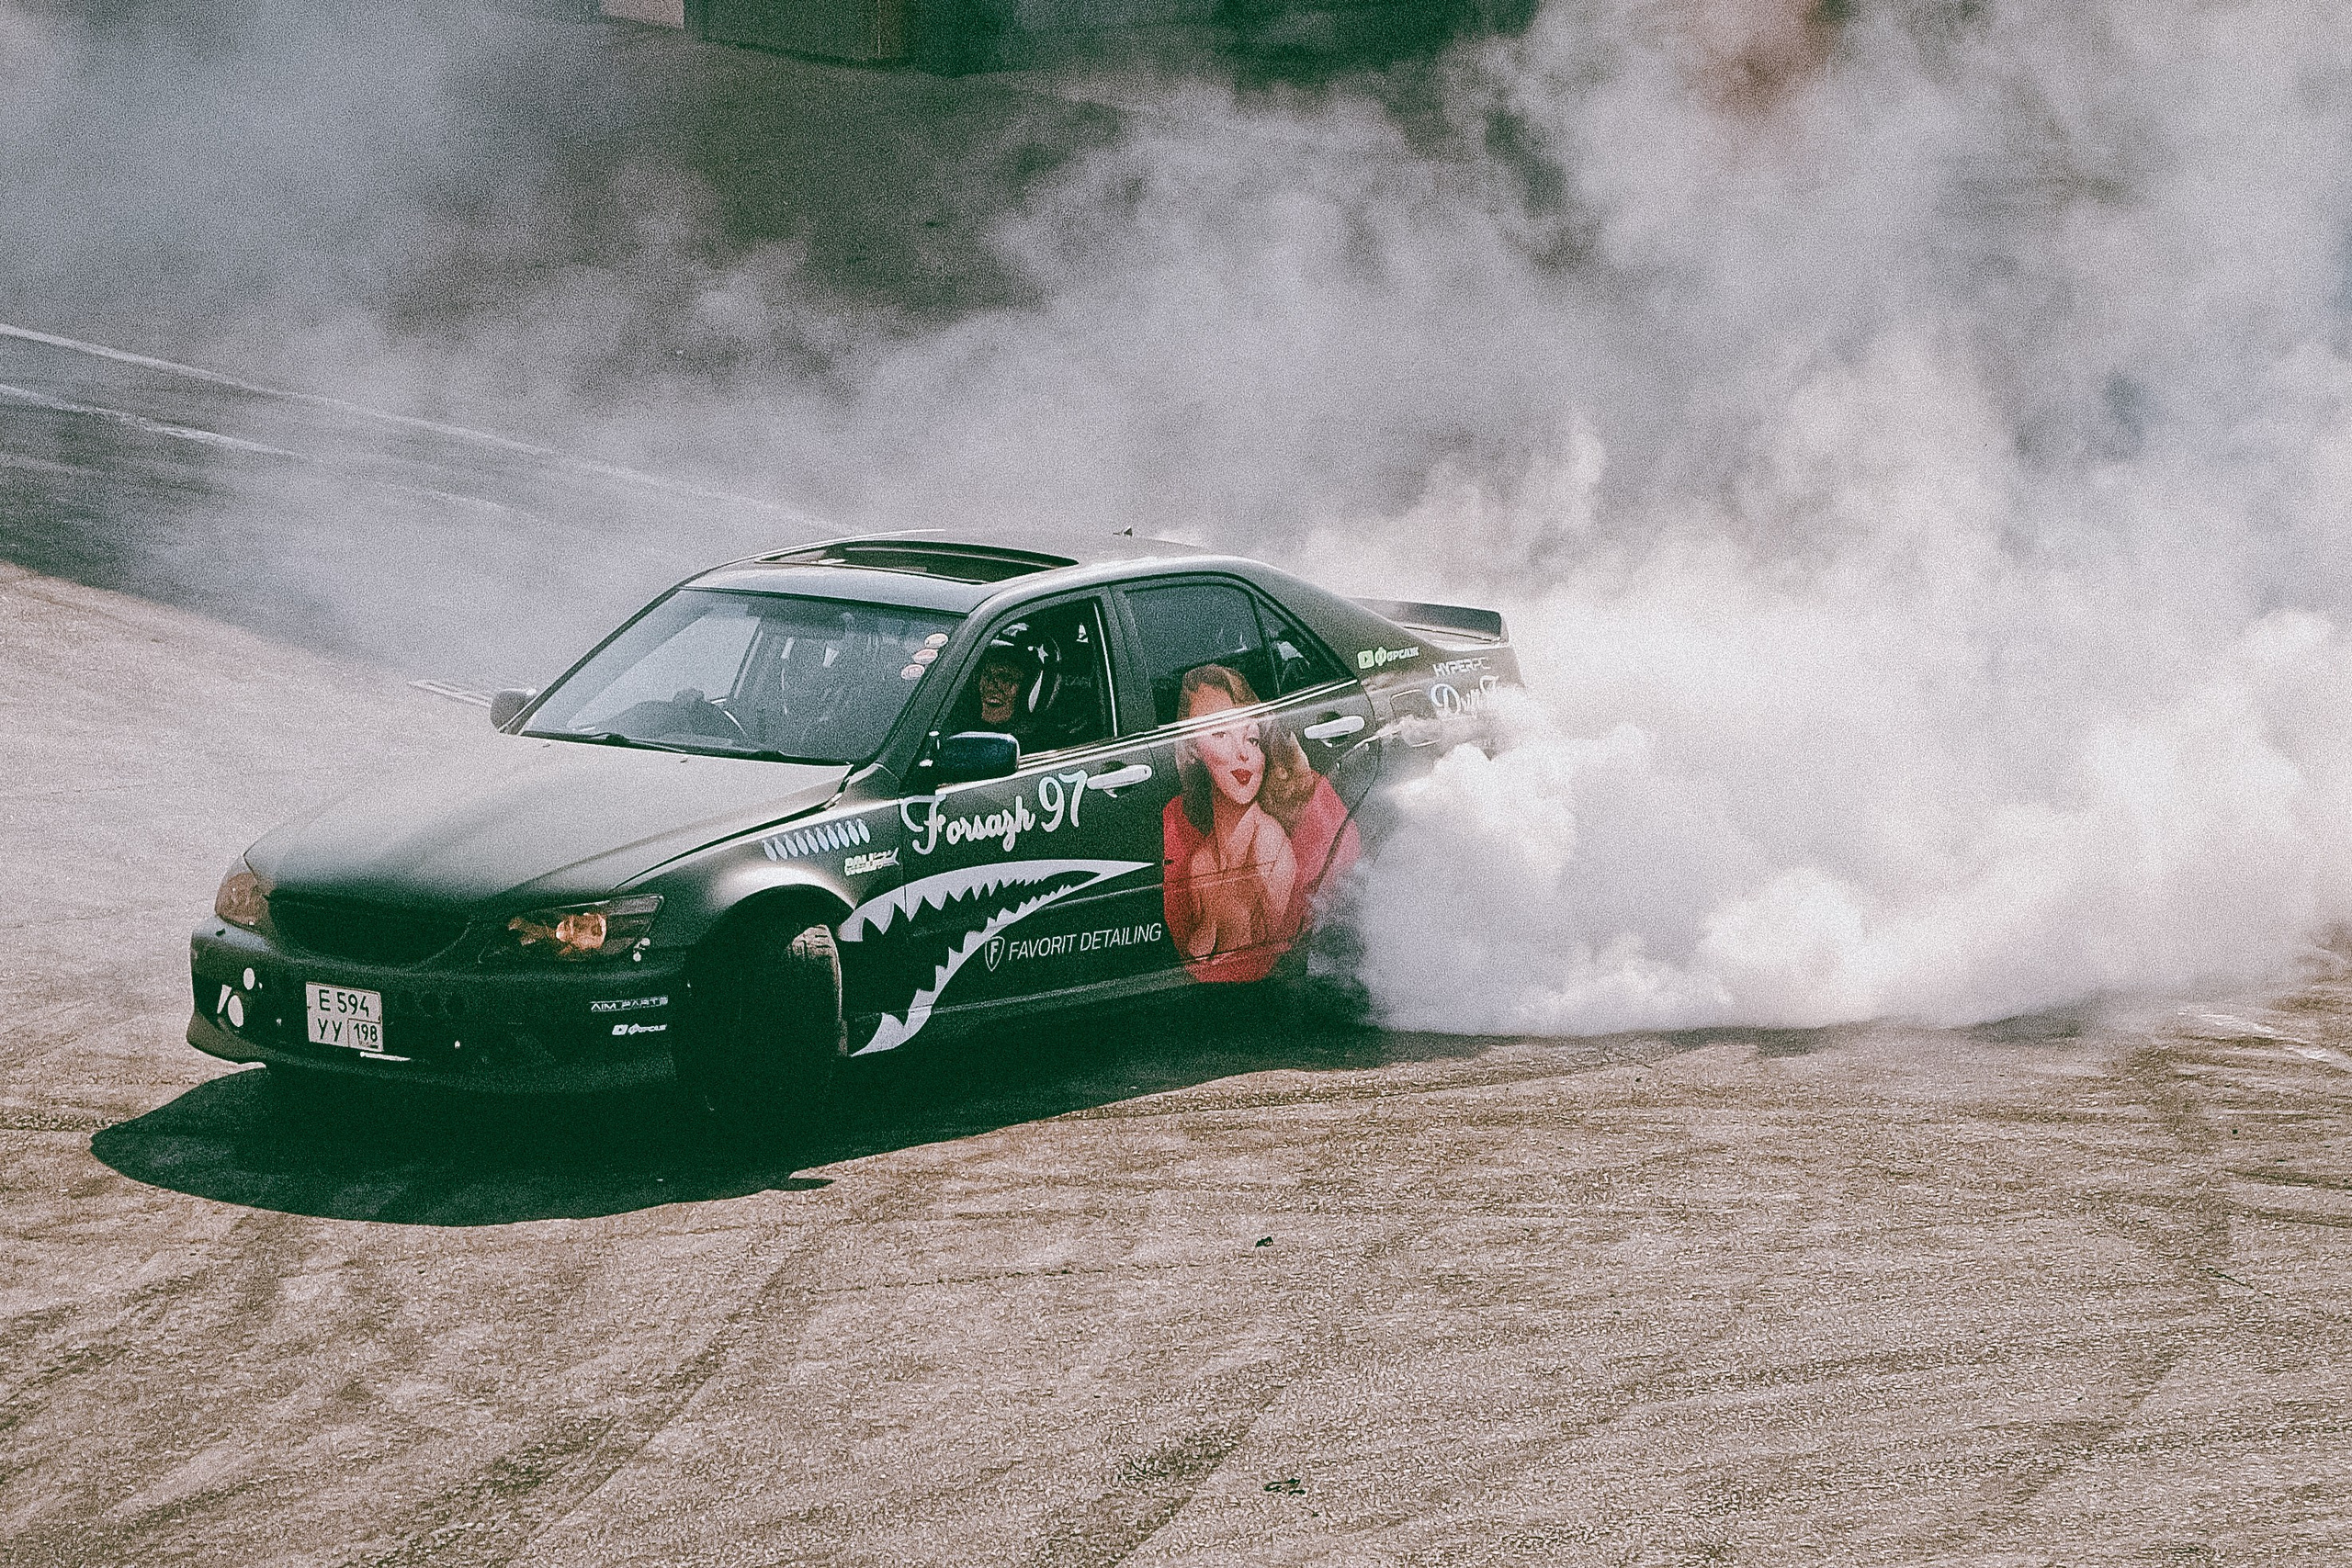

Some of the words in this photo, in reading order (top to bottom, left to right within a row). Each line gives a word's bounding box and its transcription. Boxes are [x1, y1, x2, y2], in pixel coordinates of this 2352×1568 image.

[1433, 657, 1491, 677] HYPERPC
[900, 794, 1035, 854] Forsazh
[1039, 770, 1088, 832] 97
[1009, 933, 1077, 961] FAVORIT
[1080, 922, 1162, 952] DETAILING
[336, 991, 368, 1017] 594
[591, 1002, 616, 1011] AIM
[354, 1023, 378, 1043] 198
